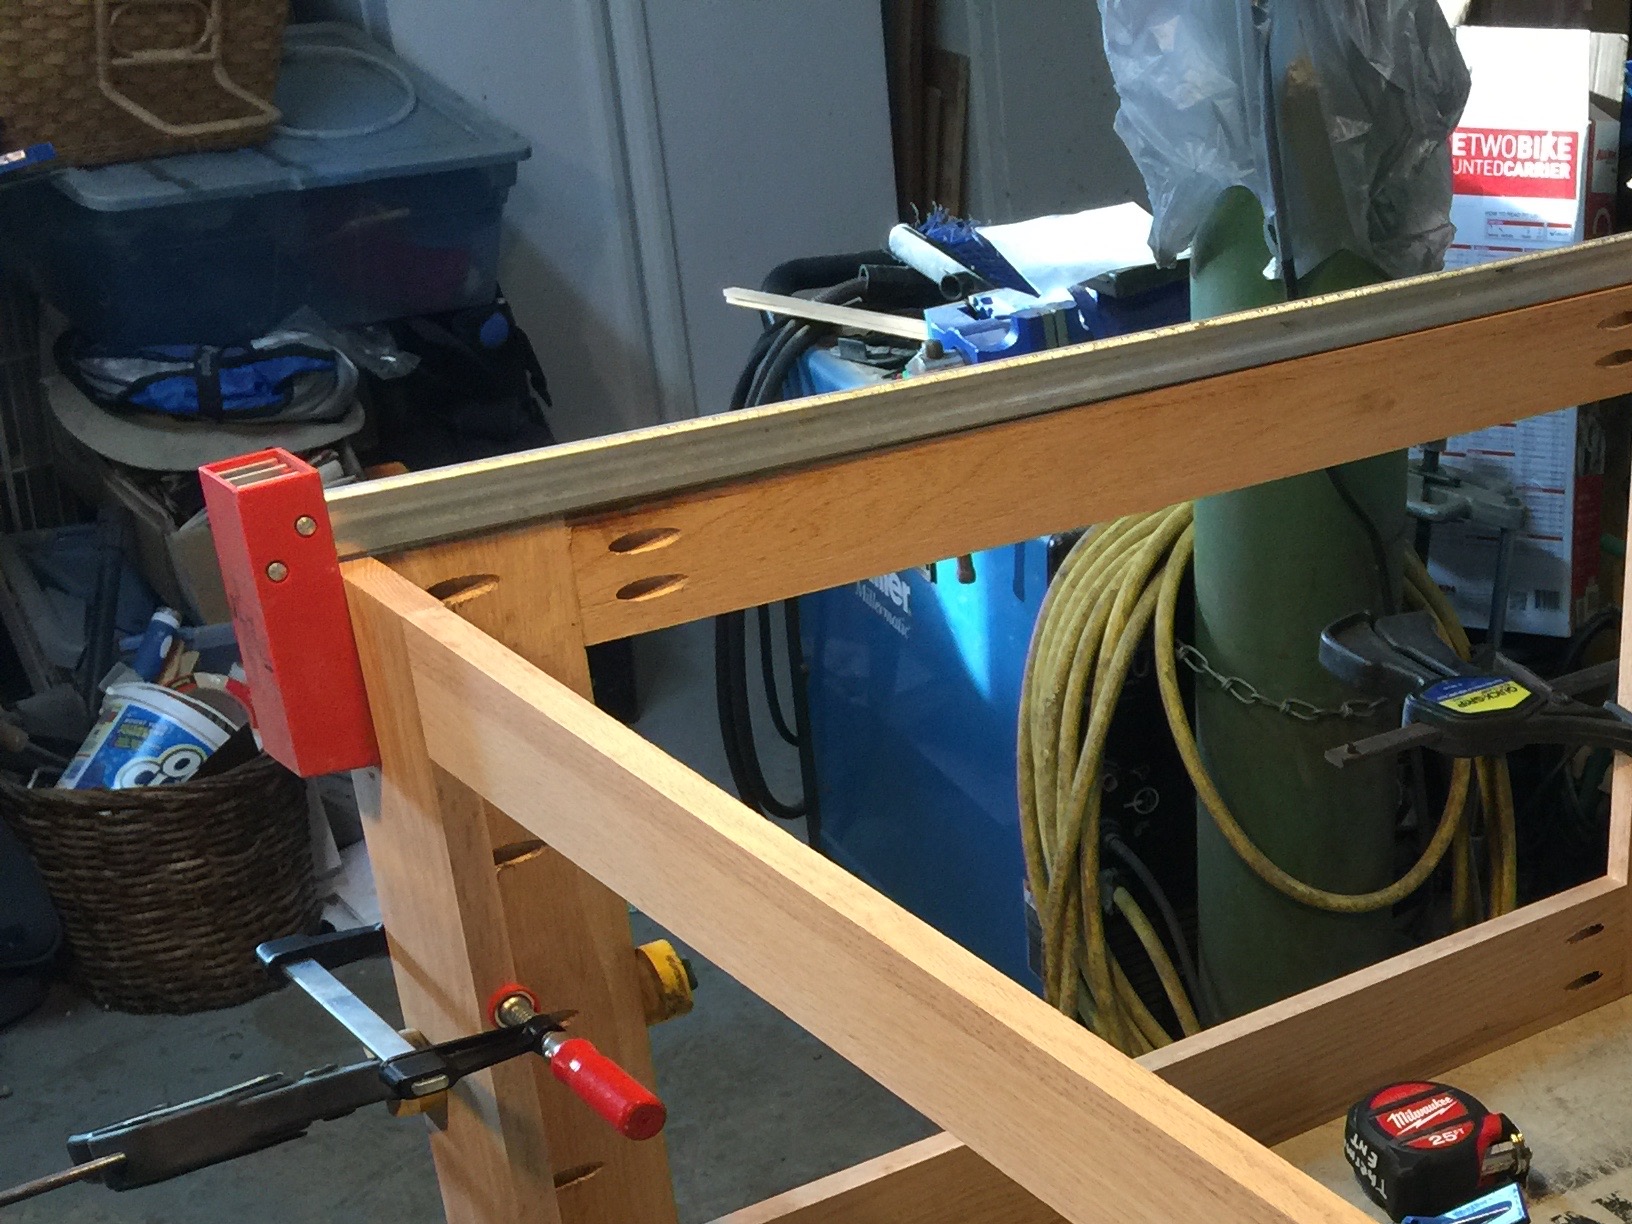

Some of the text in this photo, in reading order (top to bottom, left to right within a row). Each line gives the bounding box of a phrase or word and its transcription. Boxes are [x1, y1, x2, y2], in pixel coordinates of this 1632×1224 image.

[1452, 131, 1573, 161] ETWOBIKE
[1453, 159, 1571, 180] UNTEDCARRIER
[1387, 1096, 1454, 1130] Milwaukee
